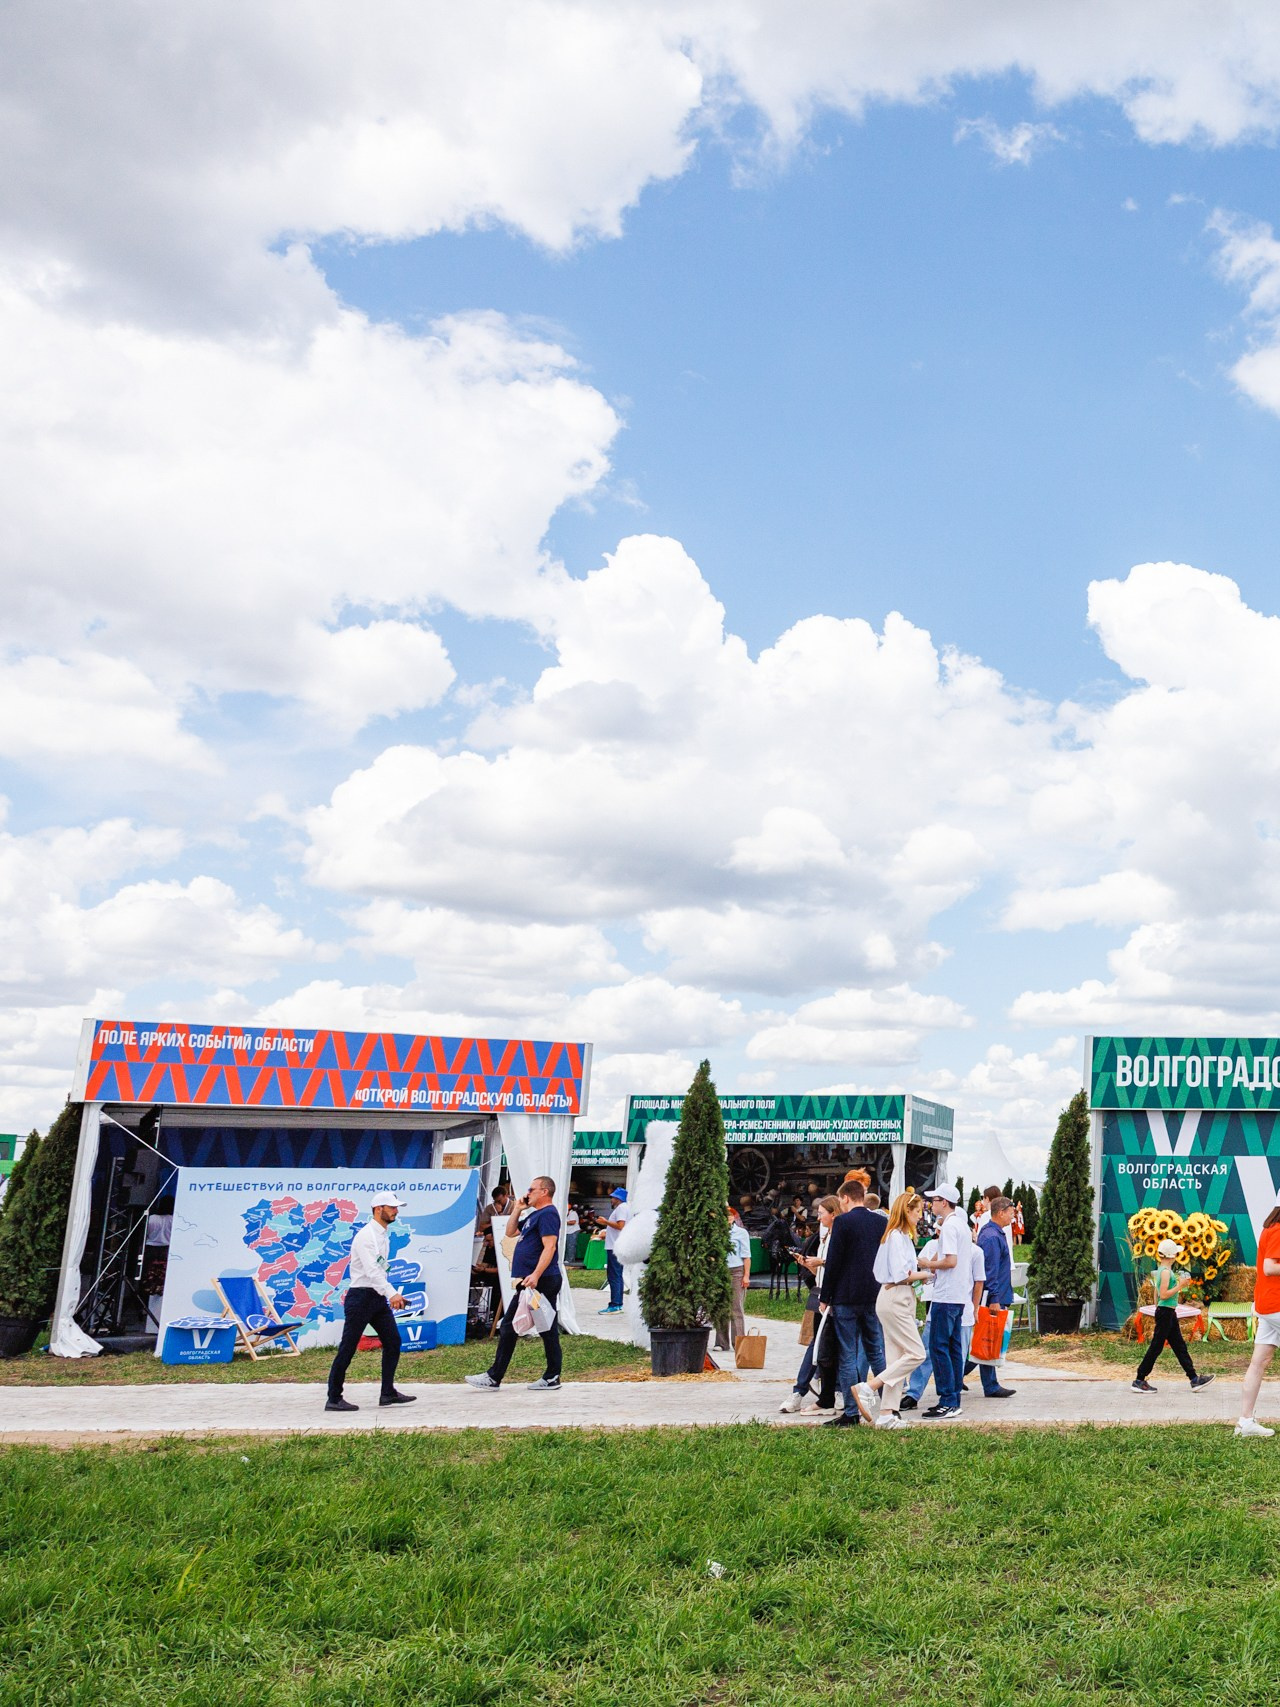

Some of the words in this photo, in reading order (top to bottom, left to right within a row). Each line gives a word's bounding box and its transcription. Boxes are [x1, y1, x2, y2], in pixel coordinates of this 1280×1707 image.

[98, 1029, 137, 1046] ПОЛЕ
[139, 1030, 186, 1048] ЯРКИХ
[188, 1033, 252, 1050] СОБЫТИЙ
[254, 1036, 314, 1053] ОБЛАСТИ
[355, 1087, 408, 1103] «ОТКРОЙ
[410, 1089, 514, 1107] ВОЛГОГРАДСКУЮ
[515, 1092, 573, 1108] ОБЛАСТЬ»
[633, 1100, 670, 1110] ПЛОЩАДЬ
[755, 1100, 776, 1110] ПОЛЯ
[724, 1120, 796, 1130] ЕРА-РЕМЕСЛЕННИКИ
[796, 1120, 902, 1130] НАРОДНО-ХУДОЖЕСТВЕННЫХ
[747, 1132, 753, 1142] И
[753, 1132, 859, 1142] ДЕКОРАТИВНО-ПРИКЛАДНОГО
[860, 1132, 901, 1142] ИСКУССТВА
[1118, 1163, 1228, 1175] ВОЛГОГРАДСКАЯ
[189, 1181, 283, 1191] ПУТЕШЕСТВУЙ
[287, 1182, 303, 1191] ПО
[307, 1181, 406, 1192] ВОЛГОГРАДСКОЙ
[409, 1182, 461, 1192] ОБЛАСТИ
[1143, 1178, 1202, 1190] ОБЛАСТЬ
